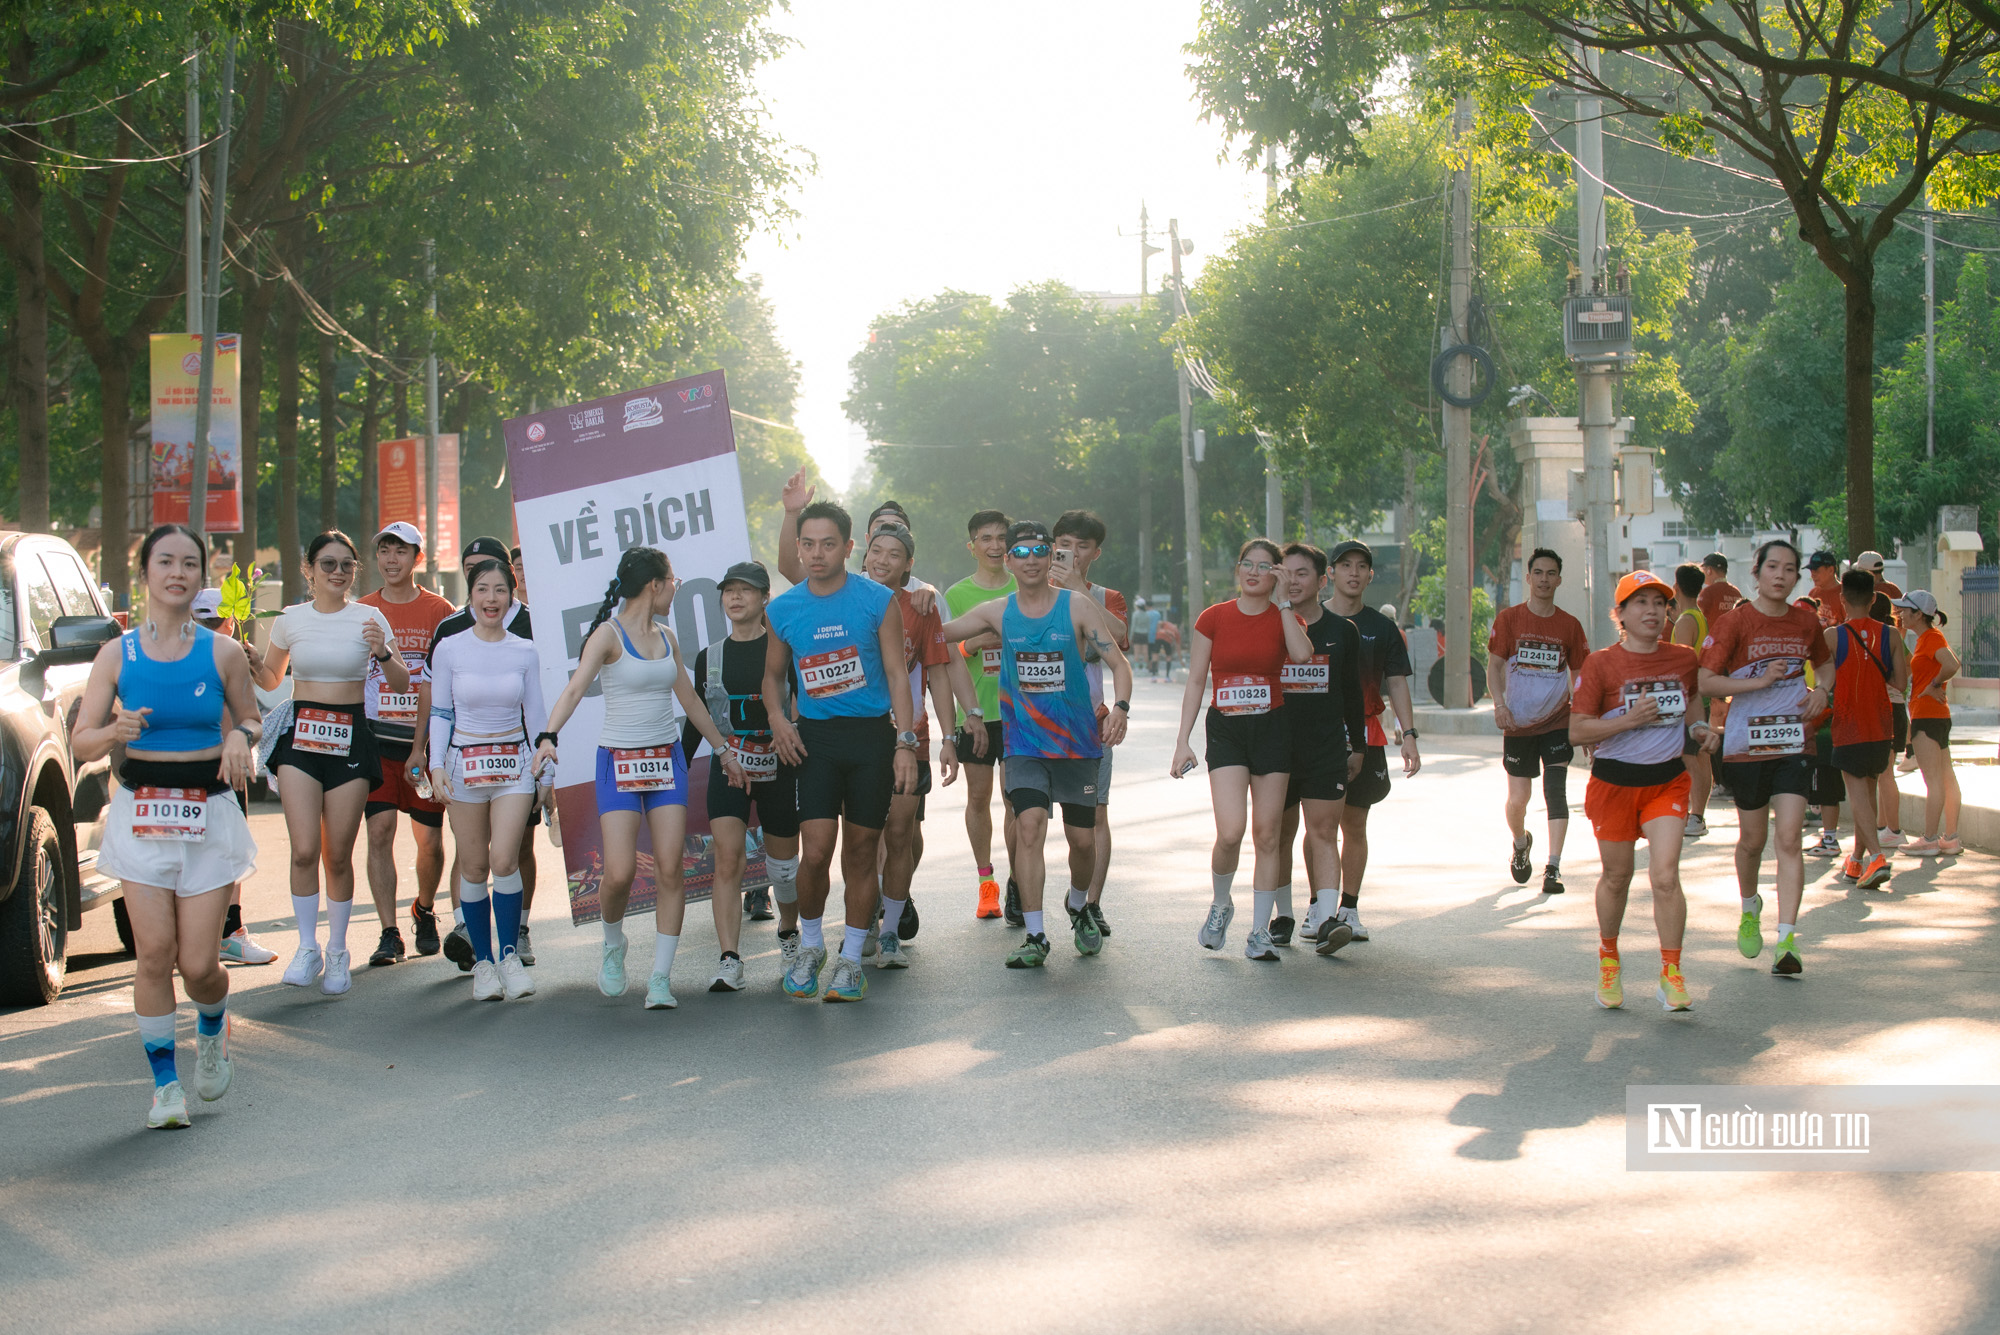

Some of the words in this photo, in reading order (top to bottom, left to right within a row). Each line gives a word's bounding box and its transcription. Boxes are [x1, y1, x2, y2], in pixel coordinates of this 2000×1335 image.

[677, 384, 713, 403] VTV8
[548, 500, 604, 565] VỀ
[614, 488, 715, 552] ĐÍCH
[406, 628, 430, 636] THUỘT
[821, 624, 843, 633] DEFINE
[813, 632, 830, 640] WHO
[834, 630, 844, 638] AM
[394, 635, 432, 650] BUSTA
[126, 638, 137, 662] asics
[1530, 651, 1557, 661] 24134
[818, 660, 857, 680] 10227
[1027, 665, 1061, 676] 23634
[1291, 667, 1326, 678] 10405
[1231, 688, 1267, 700] 10828
[1657, 694, 1681, 706] 999
[392, 696, 418, 706] 1012
[312, 724, 349, 739] 10158
[1764, 727, 1800, 739] 23996
[479, 758, 516, 770] 10300
[740, 753, 775, 767] 10366
[632, 761, 670, 774] 10314
[153, 803, 202, 819] 10189
